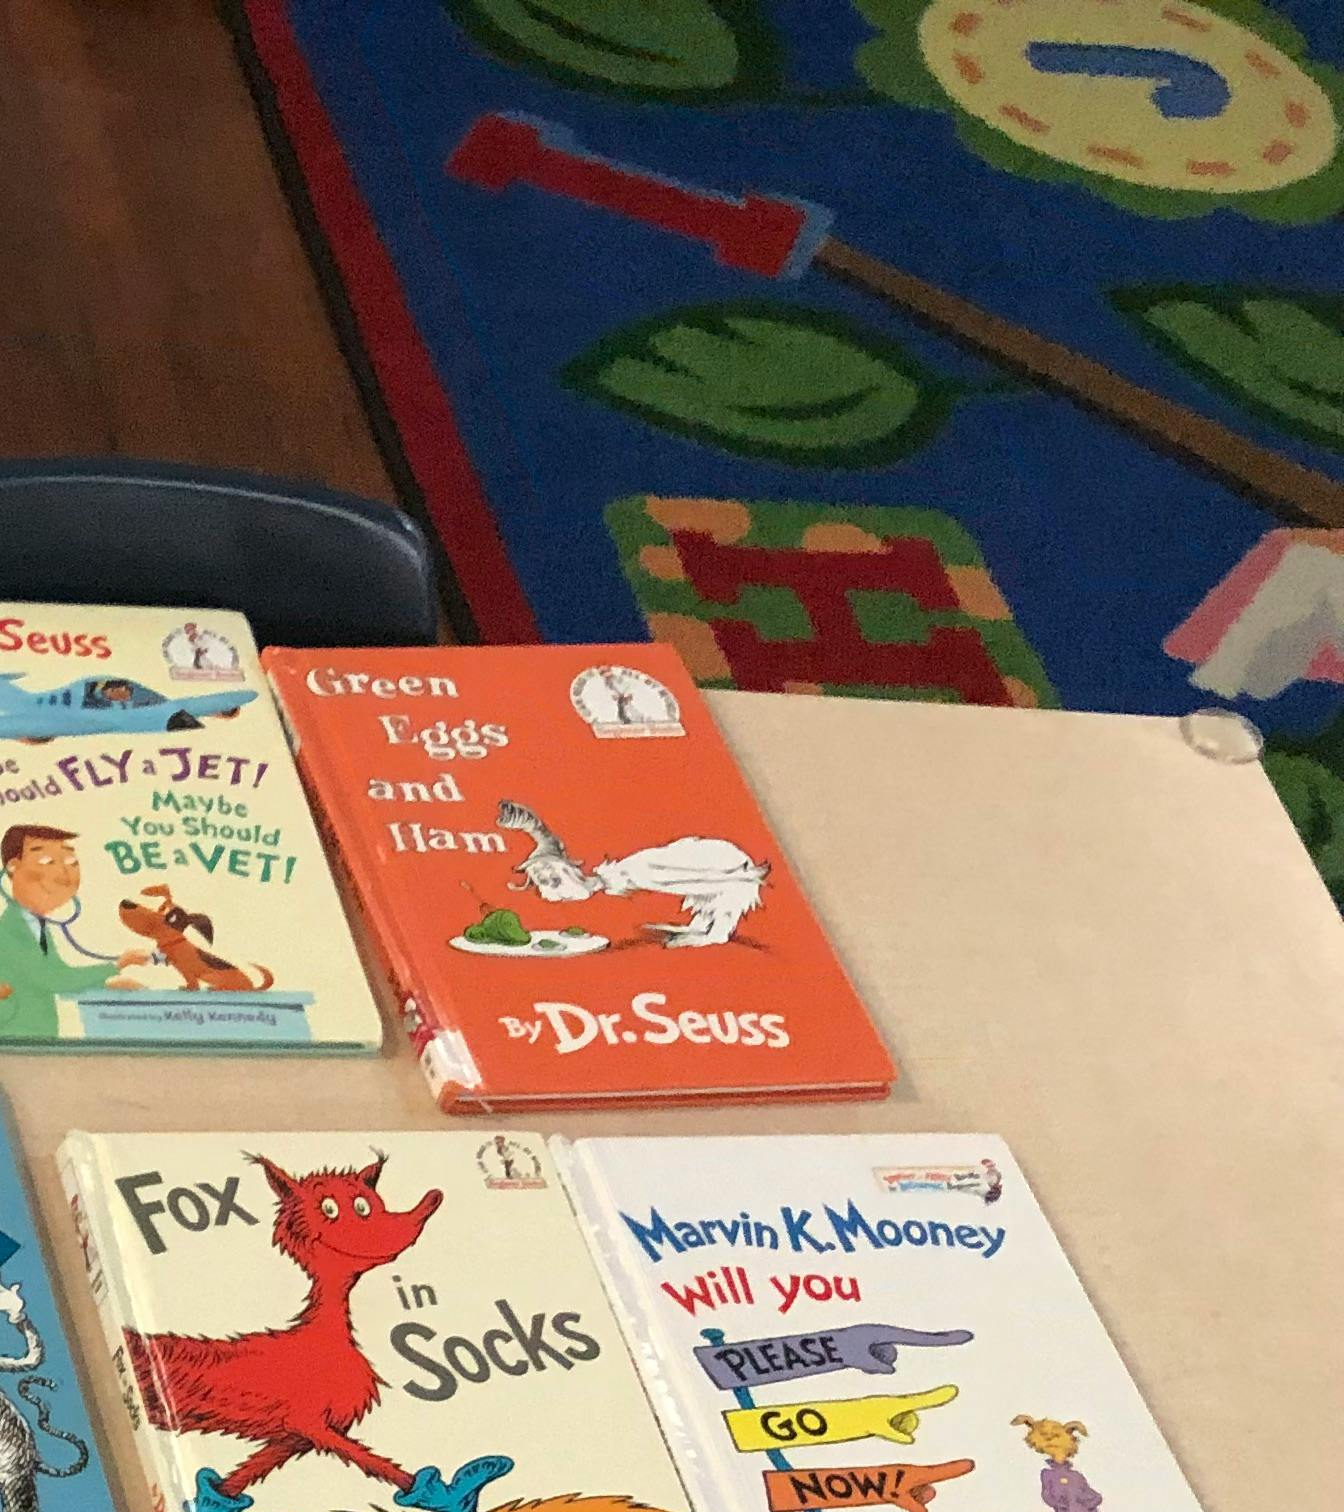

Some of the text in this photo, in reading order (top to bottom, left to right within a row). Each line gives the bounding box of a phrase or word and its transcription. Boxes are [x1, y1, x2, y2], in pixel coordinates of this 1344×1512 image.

[306, 666, 459, 700] Green
[378, 713, 510, 761] Eggs
[58, 748, 135, 792] FLY
[142, 759, 157, 776] a
[158, 746, 269, 789] JET!
[366, 773, 466, 803] and
[151, 790, 250, 819] Maybe
[121, 815, 283, 848] You Should
[386, 821, 508, 856] Ham
[104, 839, 298, 885] BE a VET!
[114, 1168, 260, 1256] Fox
[620, 1198, 1006, 1263] Marvin K. Mooney
[392, 1274, 439, 1311] in
[662, 1266, 861, 1317] Will you
[388, 1298, 602, 1404] Socks
[715, 1334, 843, 1383] PLEASE
[759, 1408, 827, 1443] GO
[790, 1459, 908, 1503] NOW!
